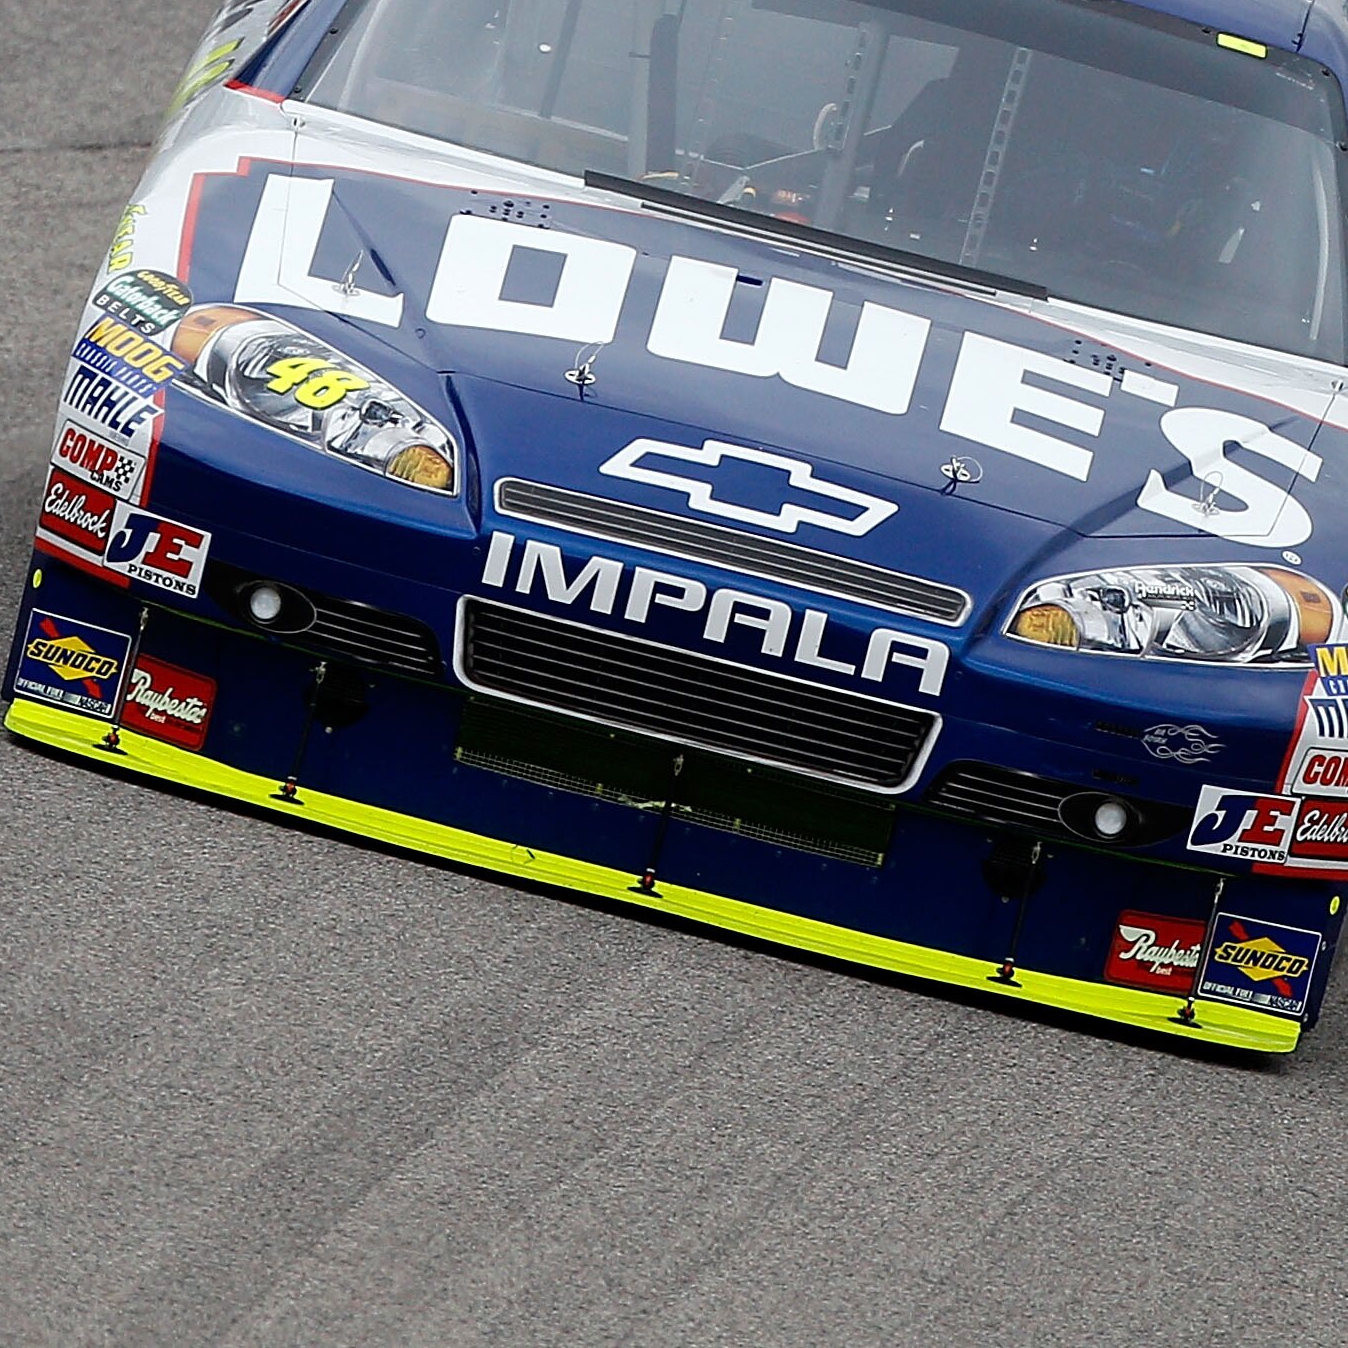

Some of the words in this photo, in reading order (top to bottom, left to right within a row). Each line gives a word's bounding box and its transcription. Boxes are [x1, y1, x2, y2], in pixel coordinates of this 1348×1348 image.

[106, 274, 182, 327] Gatorback
[137, 270, 191, 306] GOODYEAR
[95, 294, 156, 335] BELTS
[85, 315, 186, 384] MOOG
[233, 172, 1323, 548] LOWE'S
[63, 363, 159, 438] MAHLE
[265, 356, 371, 411] 48
[58, 427, 120, 474] COMP
[89, 469, 123, 493] CAMS
[44, 482, 111, 539] Edelbrock
[106, 512, 205, 579] JE
[127, 563, 197, 596] PISTONS
[1134, 580, 1195, 598] Hendrick
[481, 530, 951, 697] IMPALA
[29, 640, 116, 677] SUNOCO
[1190, 794, 1296, 847] JE
[1220, 843, 1286, 861] PISTONS
[1216, 943, 1307, 975] SUNOCO
